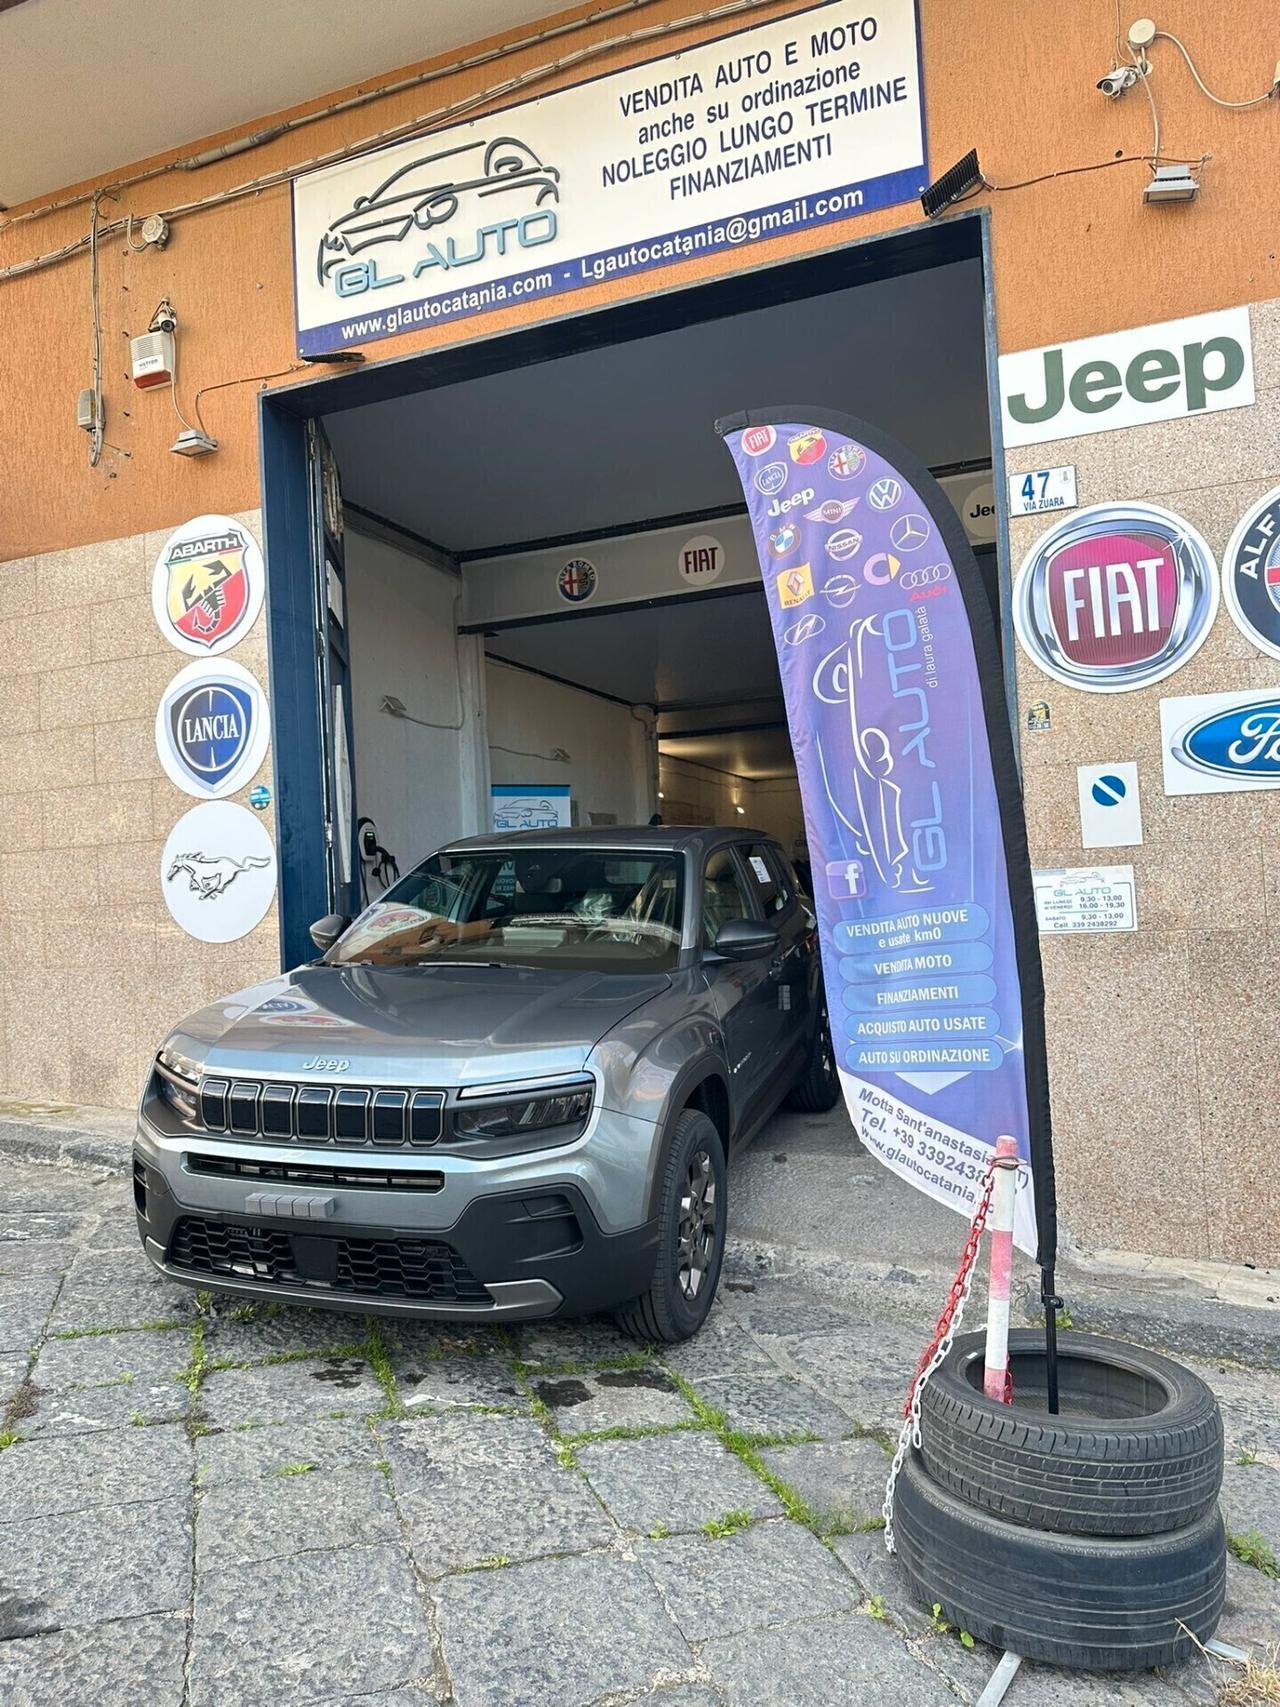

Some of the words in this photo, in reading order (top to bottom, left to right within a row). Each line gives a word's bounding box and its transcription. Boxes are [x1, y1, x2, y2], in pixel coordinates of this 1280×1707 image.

[619, 72, 703, 117] VENDITA
[715, 50, 771, 88] AUTO
[785, 41, 798, 66] E
[811, 17, 877, 58] MOTO
[639, 112, 694, 145] anche
[707, 101, 729, 123] su
[741, 61, 860, 113] ordinazione
[602, 137, 707, 188] NOLEGGIO
[720, 111, 793, 152] LUNGO
[805, 77, 907, 127] TERMINE
[670, 132, 831, 201] FINANZIAMENTI
[335, 259, 405, 297] GL
[413, 209, 558, 278] AUTO
[341, 272, 552, 340] www.glautocatania.com
[581, 189, 864, 280] Lgautocatania@gmail.com
[1007, 336, 1245, 424] Jeep
[748, 430, 769, 449] FIAT
[1021, 471, 1050, 501] 47
[767, 487, 815, 517] Jeep
[822, 506, 843, 516] MINI
[1023, 500, 1037, 511] VIA
[1038, 496, 1065, 509] ZUARA
[171, 537, 238, 560] ABARTH
[828, 536, 860, 550] NISSAN
[1240, 504, 1280, 580] ALF
[683, 547, 718, 574] FIAT
[1063, 557, 1165, 641] FIAT
[923, 644, 937, 675] laura
[882, 607, 937, 769] AUTO
[925, 676, 938, 688] di
[184, 714, 241, 745] LANCIA
[496, 819, 517, 828] GL
[519, 819, 559, 828] AUTO
[910, 781, 948, 872] GL
[1053, 889, 1073, 897] GL
[1074, 886, 1112, 896] AUTO
[1103, 894, 1123, 902] 13.00
[846, 920, 896, 937] VENDITA
[896, 914, 920, 930] AUTO
[922, 909, 968, 926] NUOVE
[1104, 912, 1124, 920] 13.00
[878, 937, 886, 948] e
[888, 932, 911, 947] usate
[873, 957, 914, 976] VENDITA
[914, 954, 952, 969] MOTO
[876, 985, 959, 1005] FINANZIAMENTI
[857, 1020, 906, 1036] ACQUISTO
[908, 1018, 940, 1032] AUTO
[943, 1016, 987, 1031] USATE
[302, 1055, 351, 1073] Jeep
[858, 1051, 888, 1065] AUTO
[889, 1051, 901, 1064] SU
[902, 1048, 991, 1063] ORDINAZIONE
[858, 1087, 894, 1116] Motta
[861, 1108, 887, 1133] Tel.
[892, 1127, 915, 1148] +39
